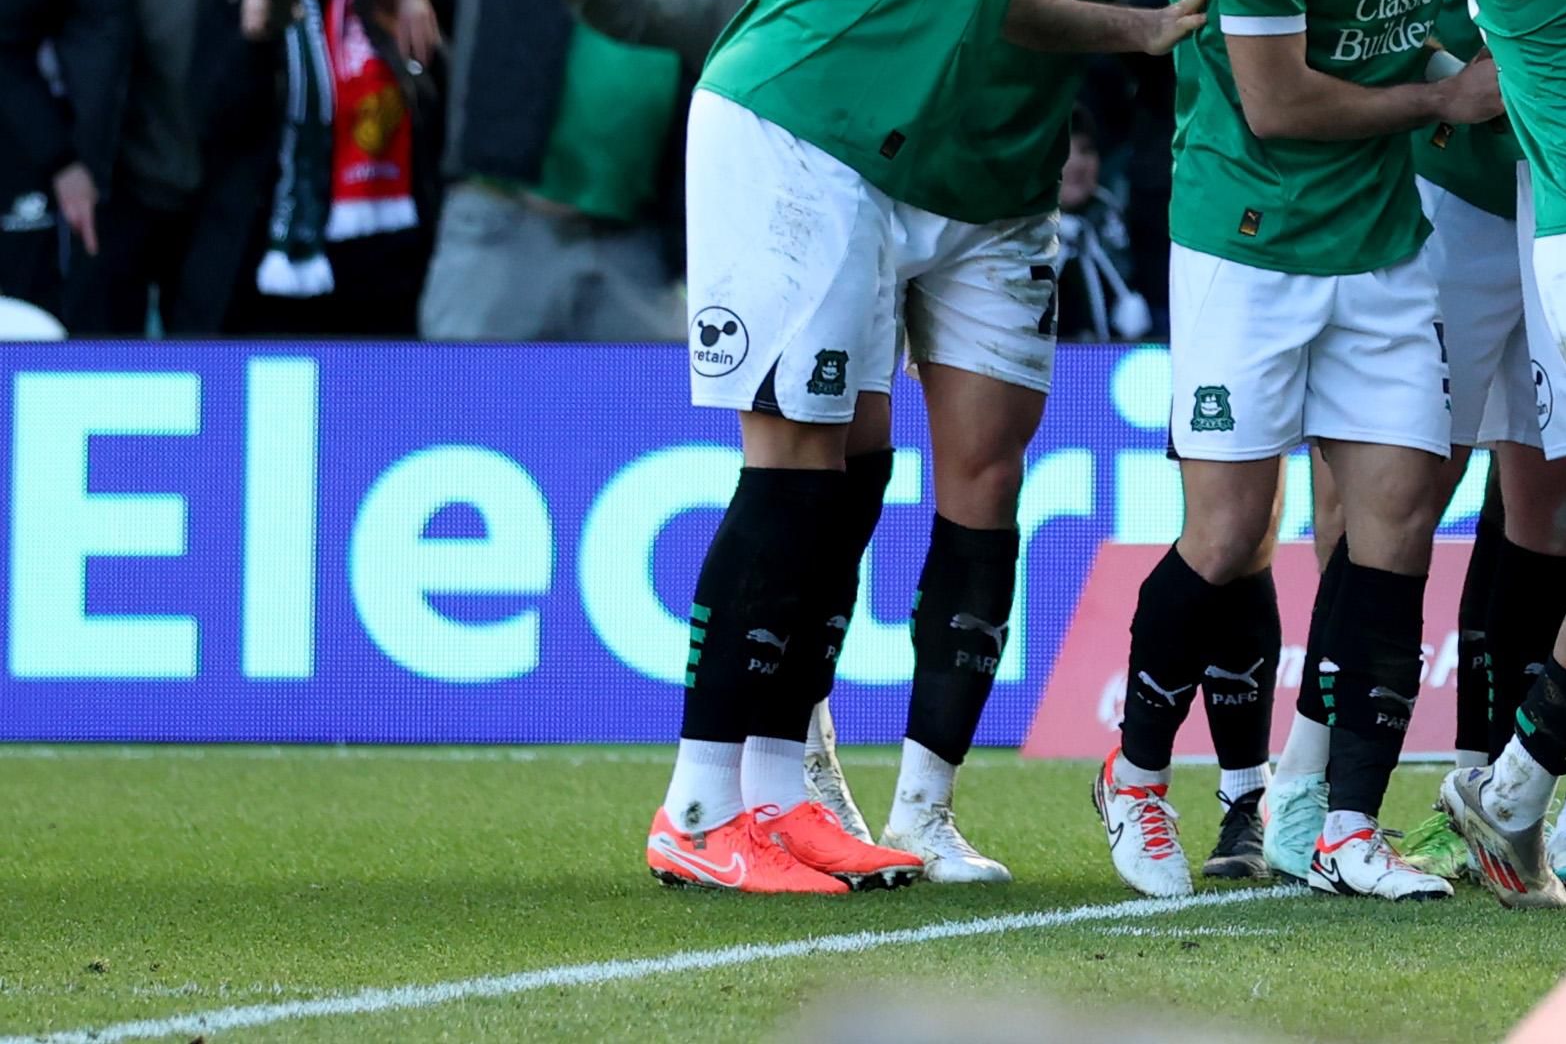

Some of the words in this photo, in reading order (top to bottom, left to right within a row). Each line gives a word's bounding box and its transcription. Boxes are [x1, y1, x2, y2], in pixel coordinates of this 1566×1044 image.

[1330, 16, 1434, 61] Builder
[693, 350, 734, 366] retain
[1211, 690, 1258, 706] PAFC
